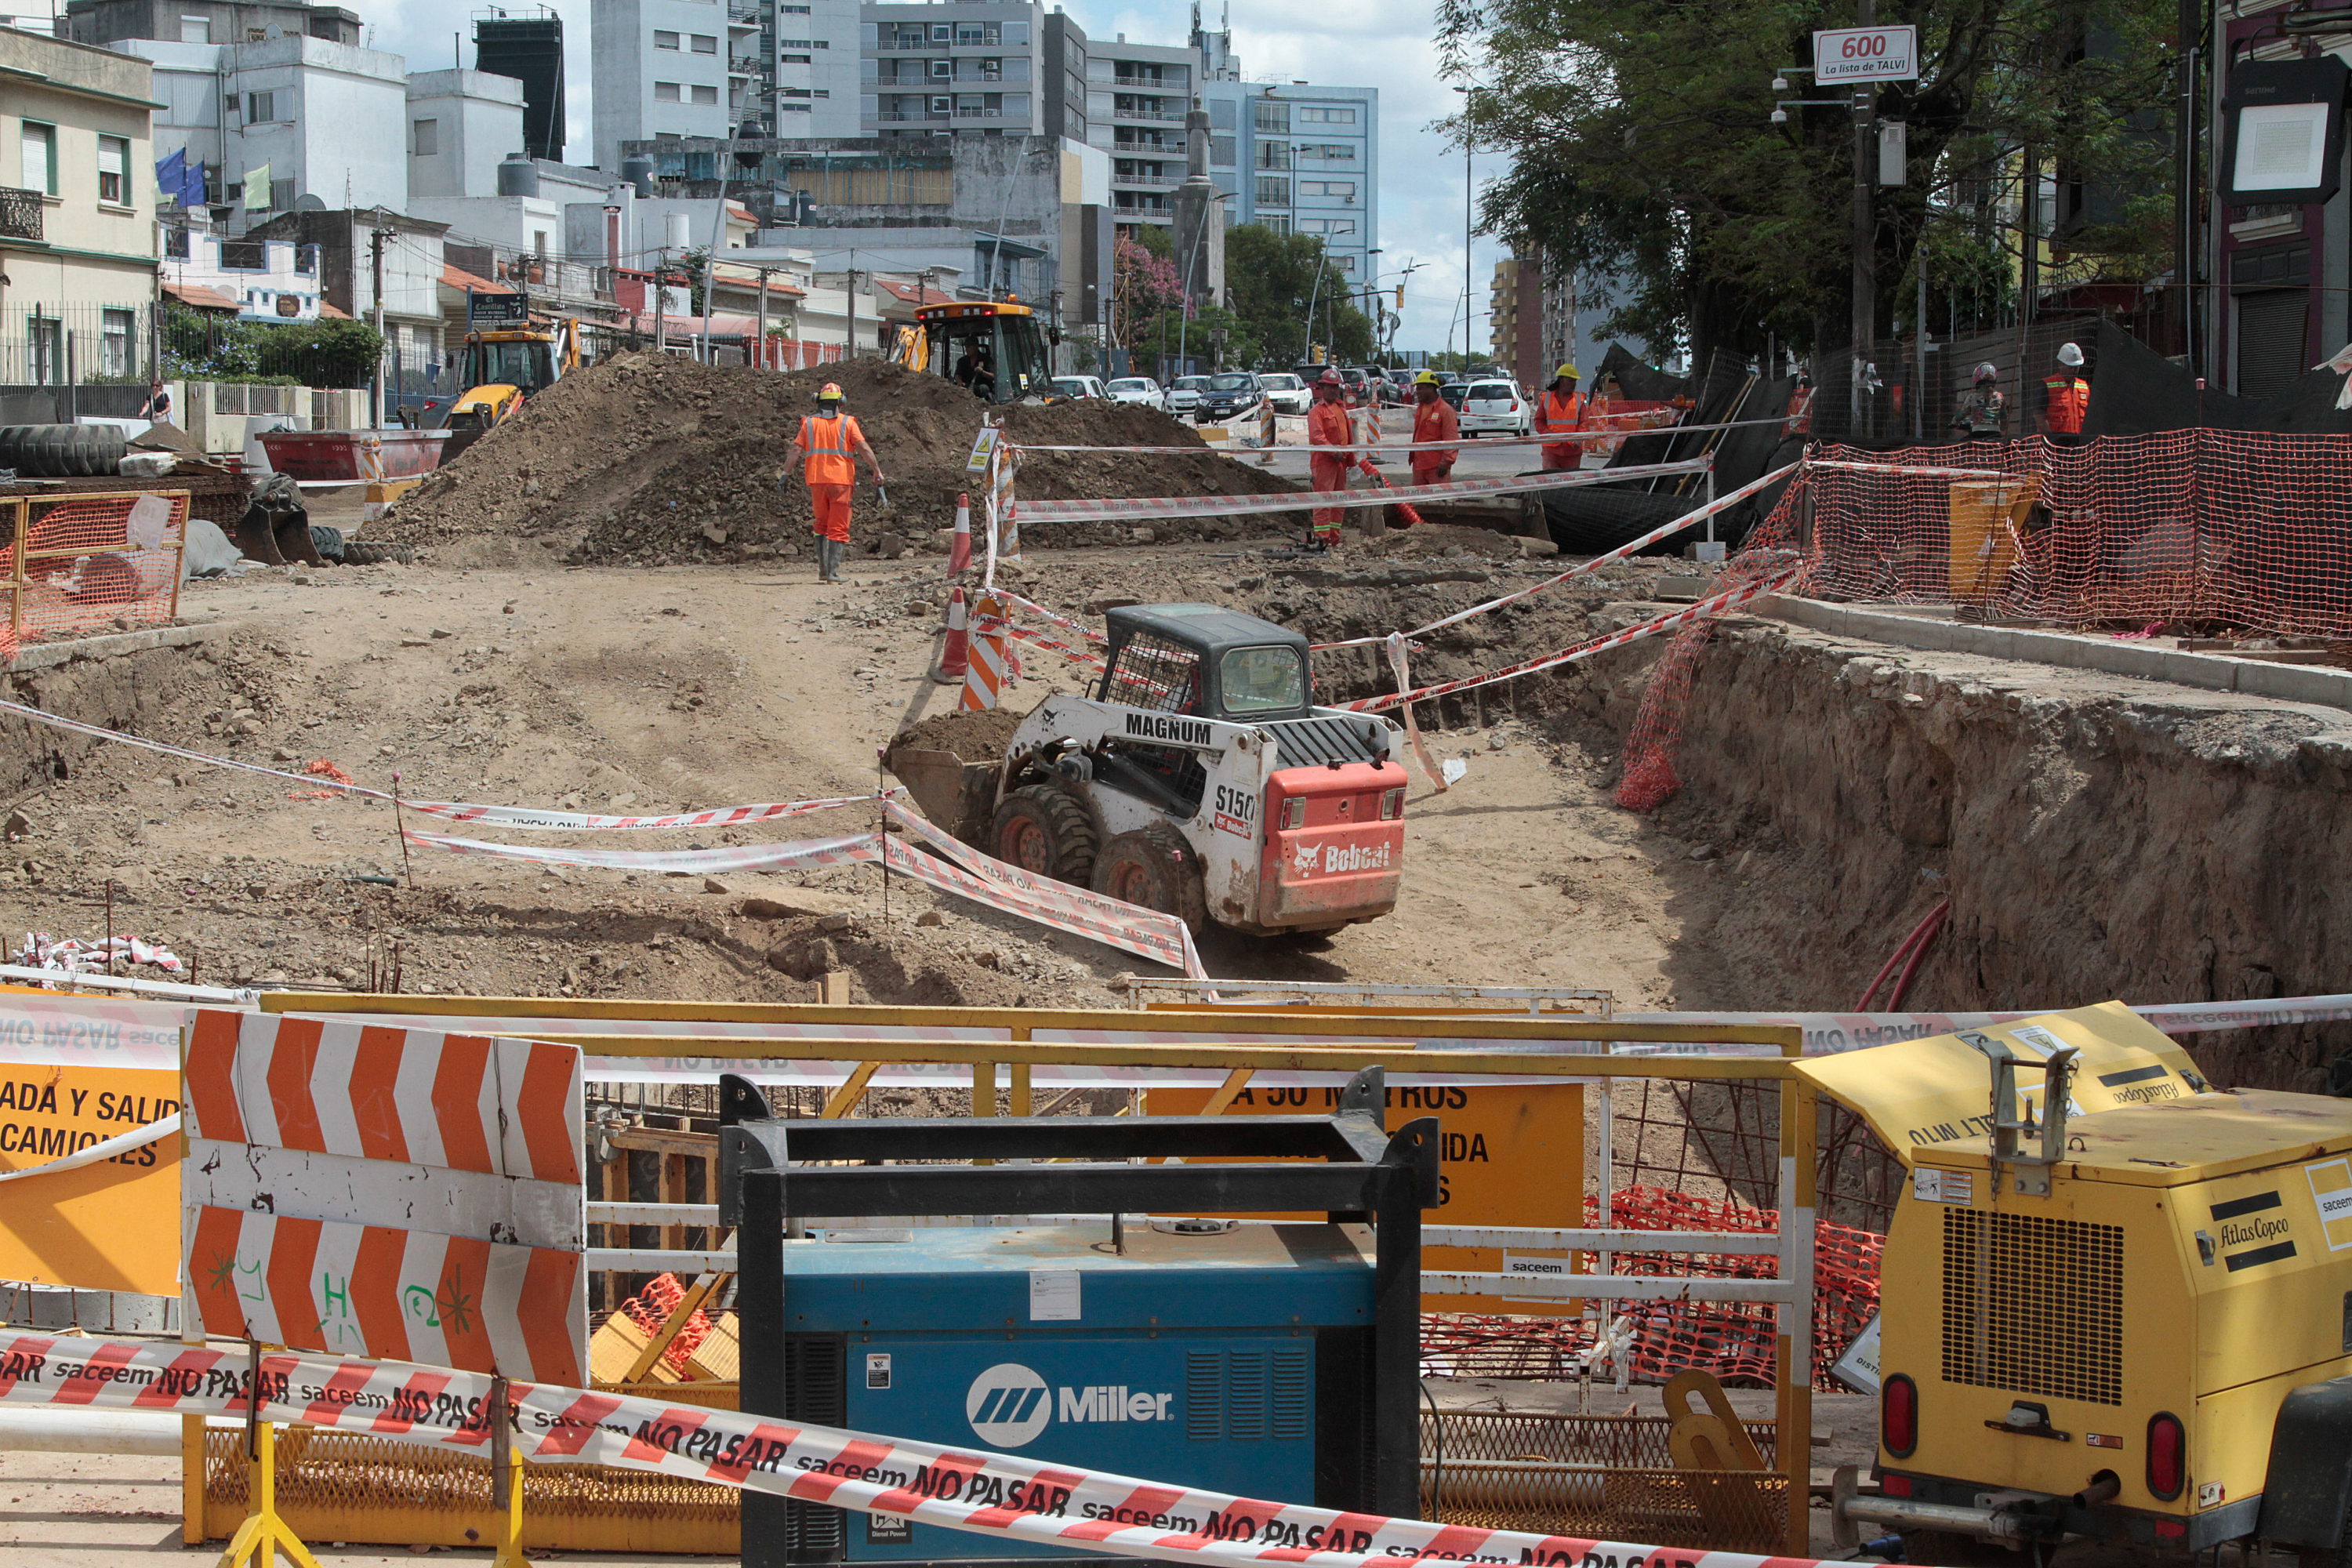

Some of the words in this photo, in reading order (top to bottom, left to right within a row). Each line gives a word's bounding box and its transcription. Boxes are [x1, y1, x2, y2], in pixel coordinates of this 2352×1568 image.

[1842, 35, 1886, 59] 600
[1825, 66, 1836, 74] La
[1839, 64, 1860, 73] lista
[1863, 62, 1874, 71] de
[1877, 60, 1905, 70] TALVI
[1374, 700, 1391, 710] NO
[1392, 691, 1427, 706] PASAR
[1469, 674, 1486, 686] NO
[1487, 665, 1519, 681] PASAR
[1579, 635, 1612, 652] PASAR
[1126, 713, 1211, 746] MAGNUM
[1215, 784, 1255, 822] S150
[1326, 840, 1392, 873] Bobcat
[71, 1088, 89, 1116] Y
[2322, 1196, 2352, 1212] saceem
[2220, 1223, 2255, 1248] Atlas
[2254, 1218, 2288, 1241] Copco
[1512, 1262, 1563, 1274] saceem
[1856, 1357, 1881, 1377] DISTI
[1058, 1385, 1168, 1423] Miller
[53, 1361, 153, 1385] saceem
[157, 1367, 203, 1397] NO
[205, 1368, 290, 1405] PASAR
[300, 1385, 389, 1410] saceem
[392, 1386, 433, 1424] NO
[636, 1420, 682, 1454] NO
[685, 1428, 788, 1473] PASAR
[794, 1455, 907, 1488] saceem
[909, 1464, 963, 1501] NO
[963, 1472, 1073, 1519] PASAR
[1080, 1501, 1198, 1534] saceem
[1201, 1511, 1257, 1543] NO
[1258, 1519, 1374, 1555] PASAR
